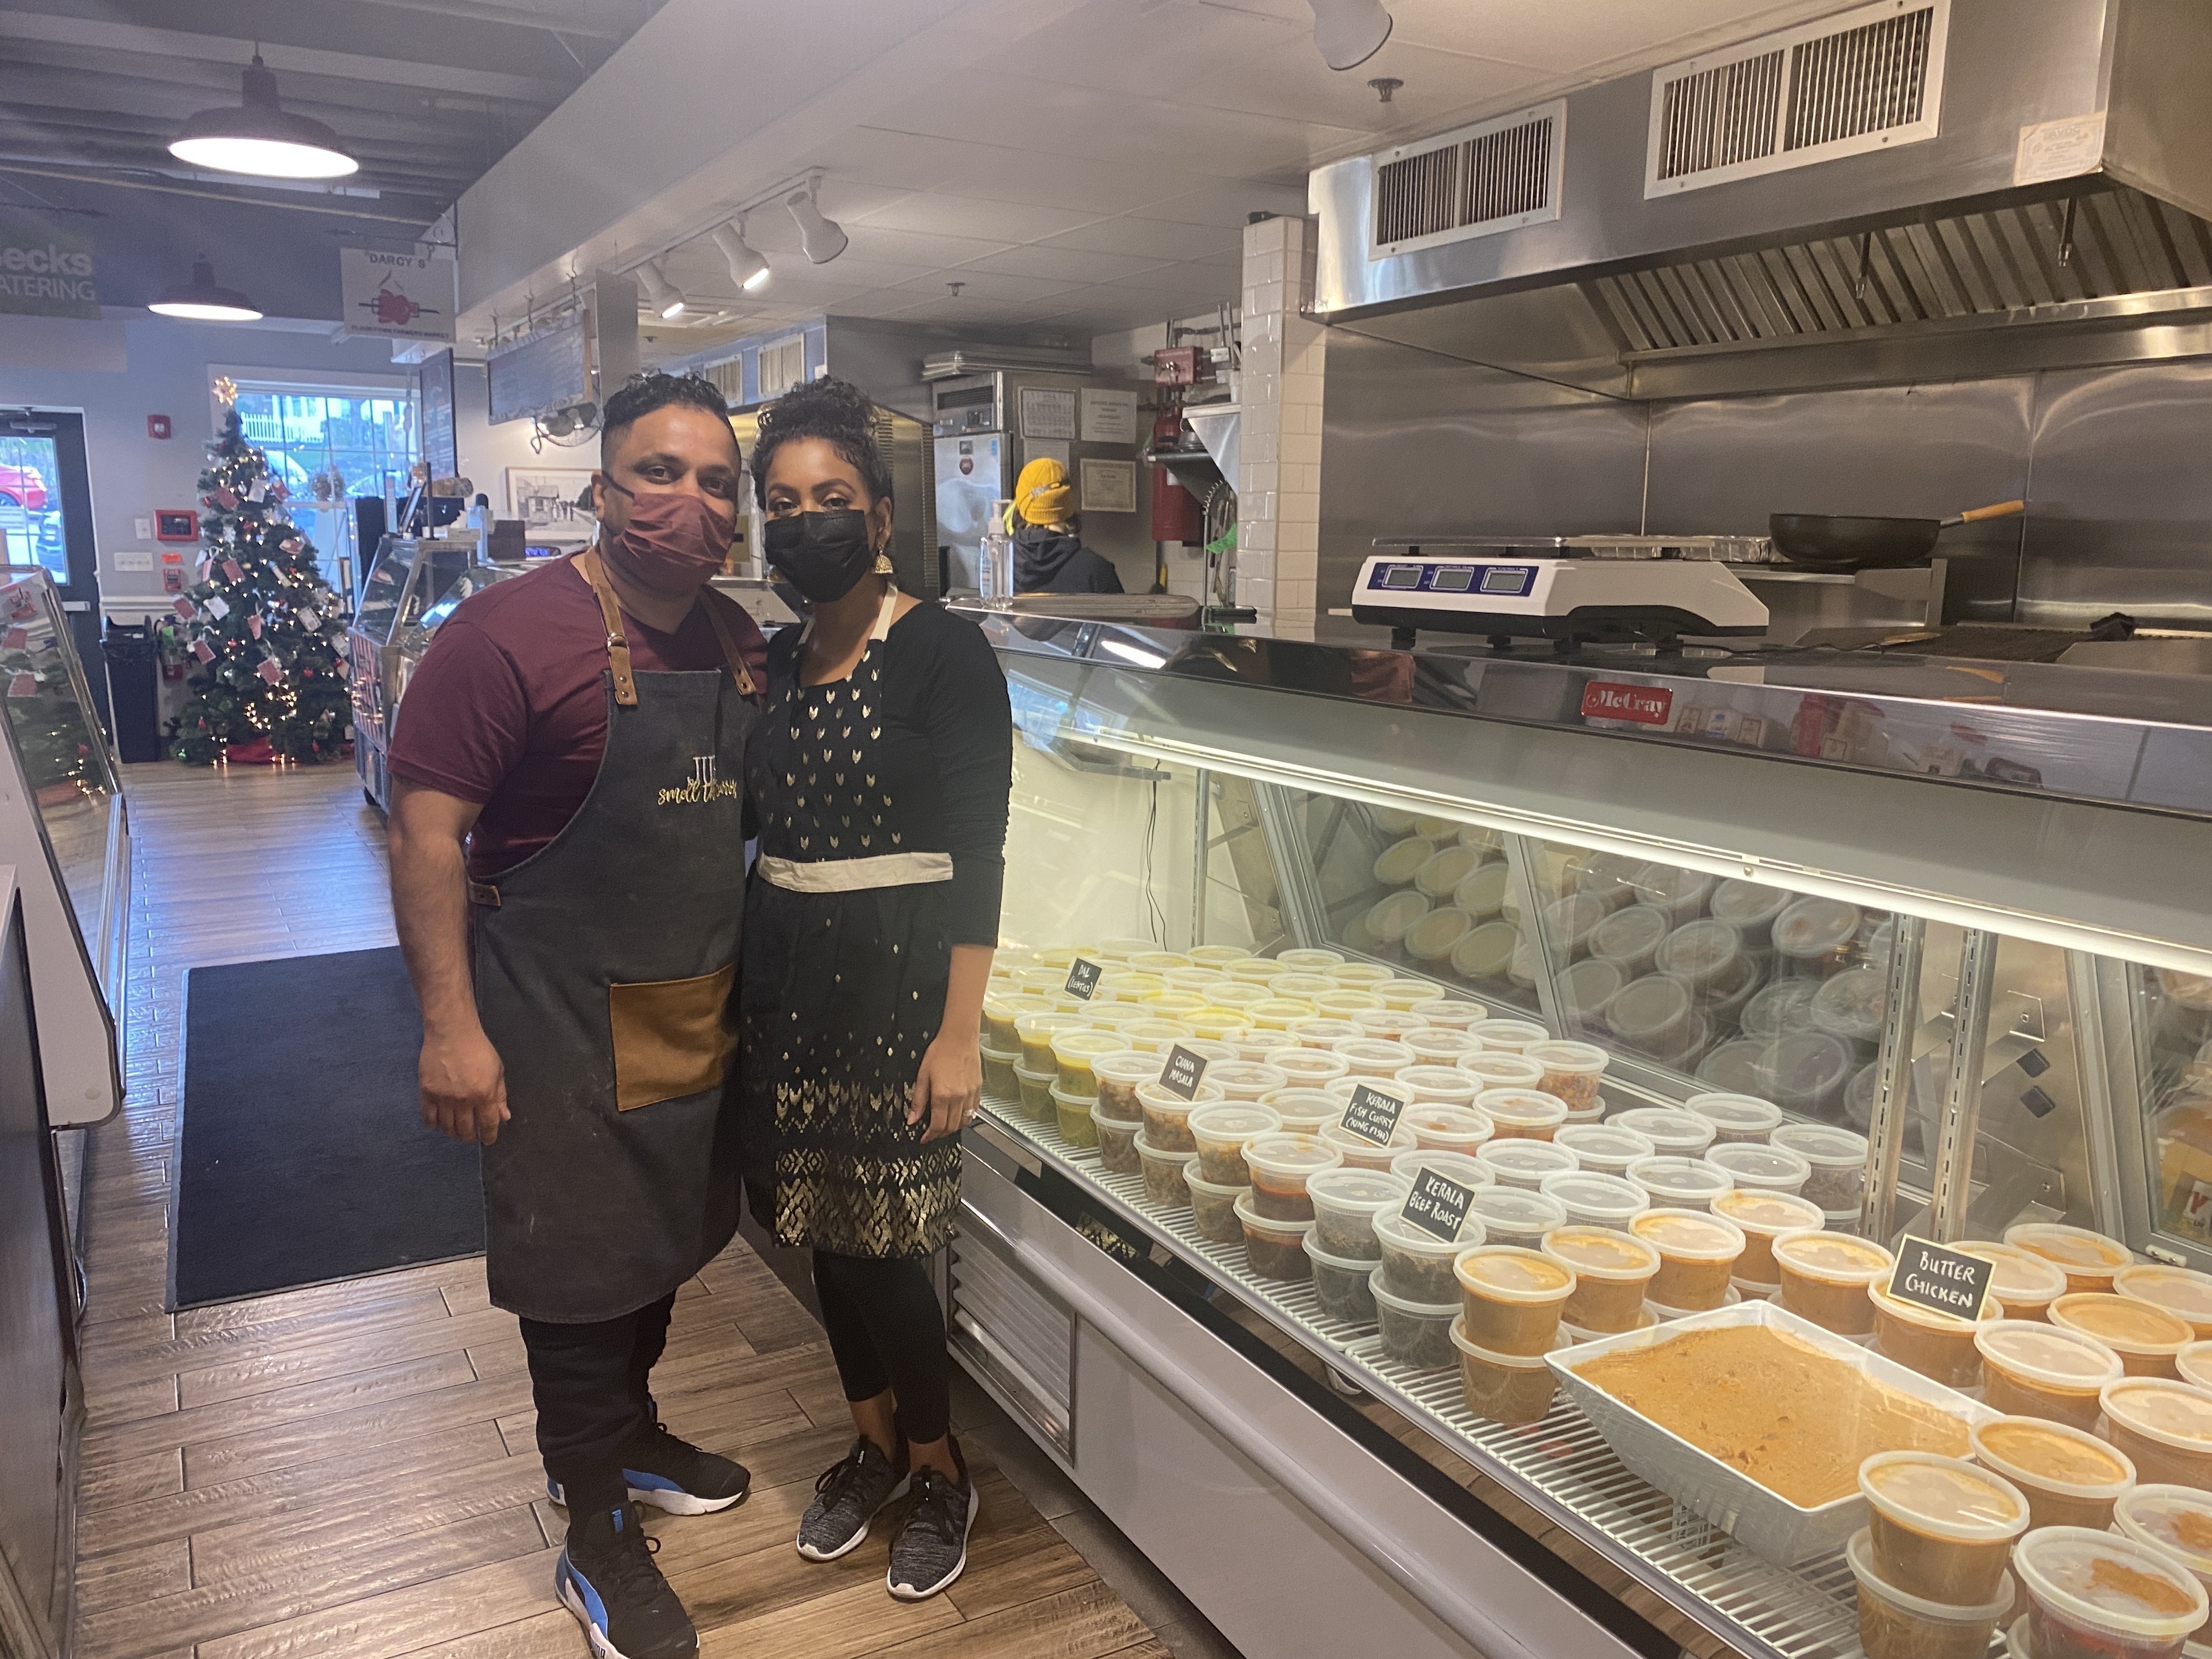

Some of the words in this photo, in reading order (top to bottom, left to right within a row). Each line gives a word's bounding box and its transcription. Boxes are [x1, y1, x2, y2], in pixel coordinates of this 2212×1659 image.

[1586, 690, 1667, 718] McCray
[1175, 1055, 1195, 1073] CHANA
[1169, 1068, 1194, 1088] MASALA
[1349, 1103, 1368, 1118] FISH
[1369, 1110, 1395, 1129] CURRY
[1366, 1092, 1395, 1114] KERALA
[1346, 1117, 1369, 1133] (KING
[1369, 1126, 1389, 1143] FISH)
[1425, 1176, 1465, 1210] KERALA
[1409, 1191, 1432, 1212] BEEF
[1430, 1201, 1462, 1230] ROAST
[1919, 1251, 1975, 1286] BUTTER
[1904, 1273, 1973, 1308] CHICKEN
